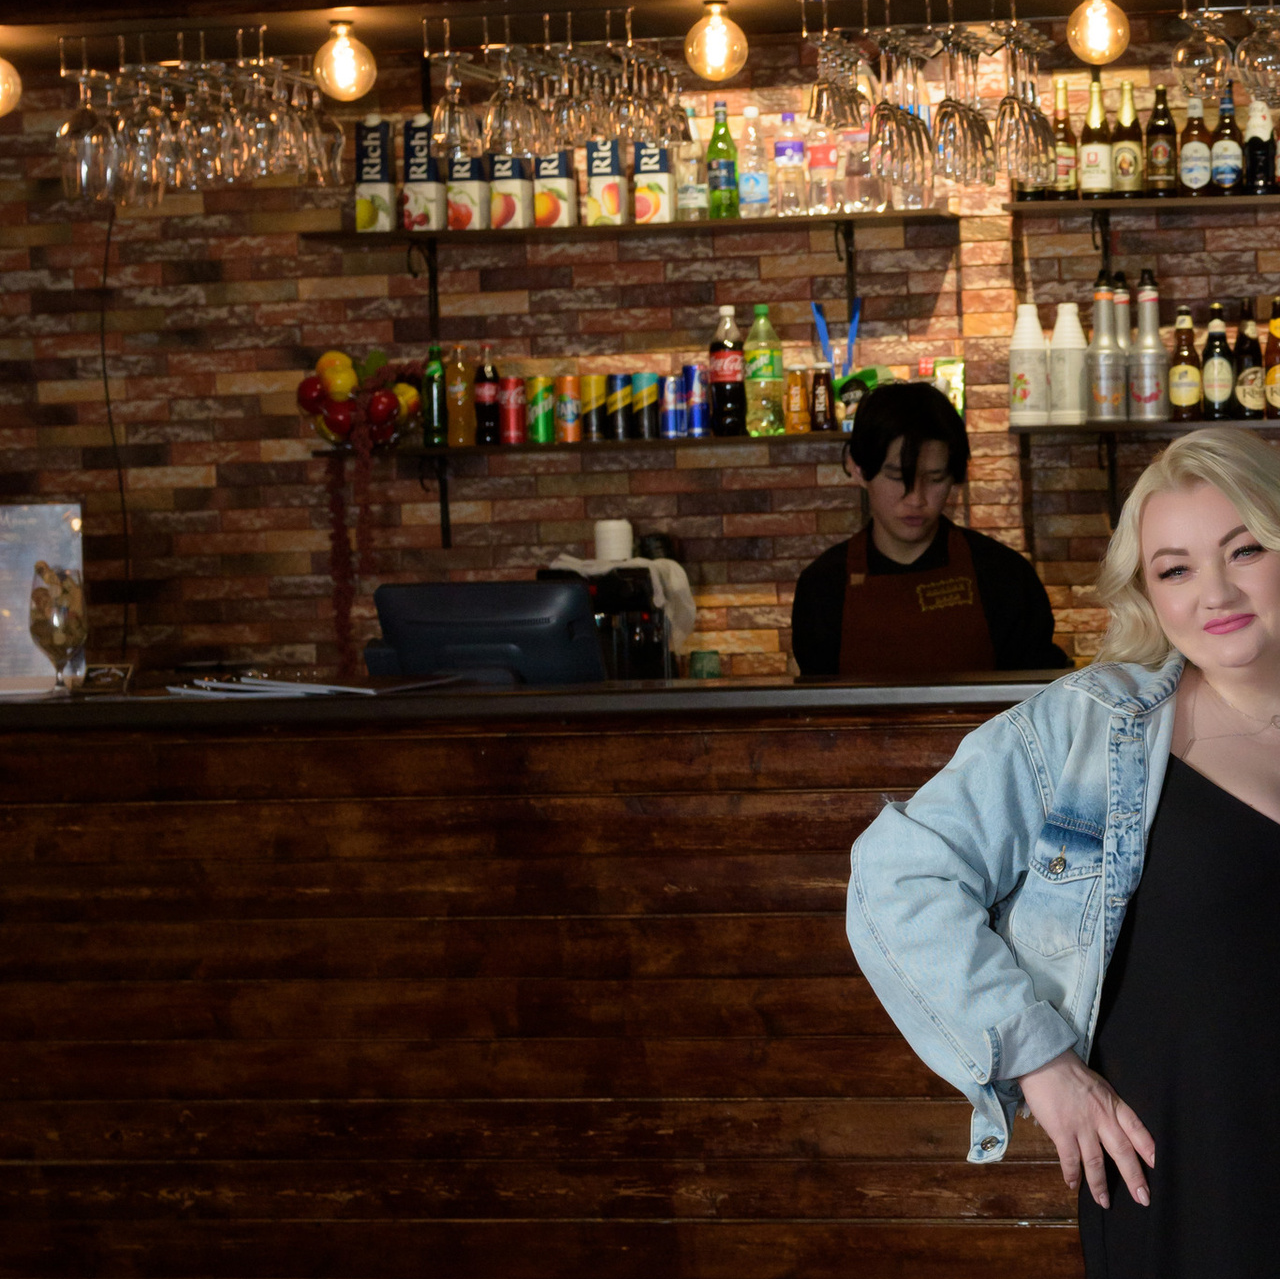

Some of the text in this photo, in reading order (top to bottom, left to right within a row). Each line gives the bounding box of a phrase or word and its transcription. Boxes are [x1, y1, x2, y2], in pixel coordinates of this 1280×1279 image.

[362, 132, 382, 180] Rich
[409, 132, 428, 180] Rich
[592, 140, 612, 173] Ric
